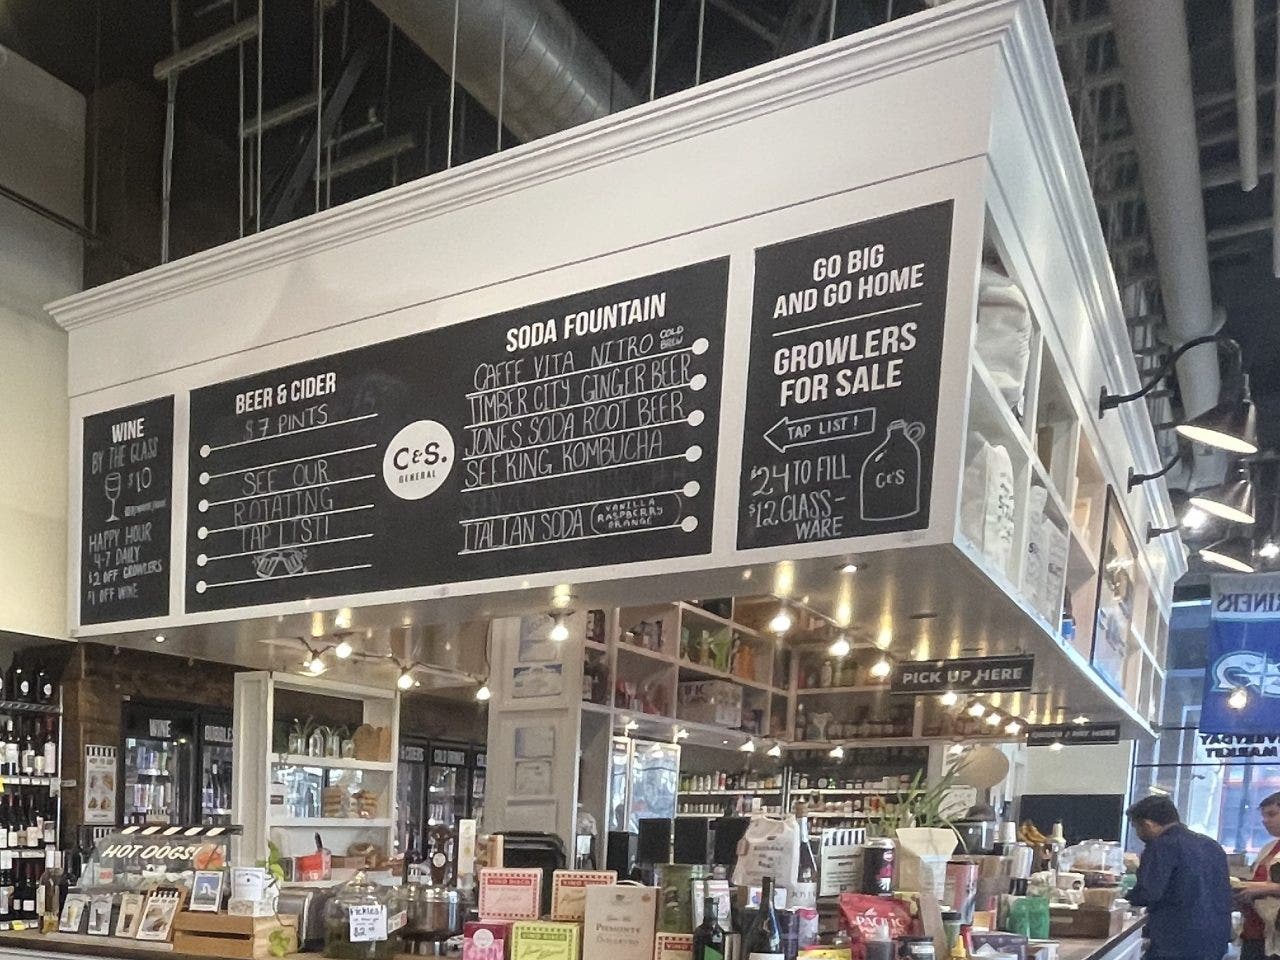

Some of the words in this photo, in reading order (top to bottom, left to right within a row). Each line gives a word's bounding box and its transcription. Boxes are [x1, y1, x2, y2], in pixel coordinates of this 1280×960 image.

[813, 254, 841, 282] GO
[848, 244, 884, 273] BIG
[773, 288, 816, 318] AND
[823, 280, 852, 308] GO
[858, 264, 924, 299] HOME
[506, 318, 557, 352] SODA
[564, 292, 666, 340] FOUNTAIN
[659, 326, 684, 339] COLD
[473, 357, 524, 391] CAFFE
[533, 351, 575, 378] VITA
[590, 333, 654, 368] NITRO
[773, 322, 917, 376] GROWLERS
[236, 388, 272, 415] BEER
[277, 383, 287, 405] &
[291, 372, 337, 402] CIDER
[468, 393, 528, 427] TIMBER
[533, 378, 571, 412] CITY
[581, 364, 646, 403] GINGER
[651, 354, 691, 388] BEER
[780, 373, 828, 407] FOR
[836, 359, 903, 397] SALE
[111, 418, 145, 443] WINE
[278, 404, 328, 435] PINTS
[465, 421, 522, 457] JONES
[528, 413, 575, 444] SODA
[582, 401, 629, 436] ROOT
[637, 391, 687, 427] BEER
[787, 426, 811, 441] TAP
[91, 450, 104, 474] BY
[110, 445, 126, 470] THE
[130, 436, 159, 464] GLASS
[563, 430, 663, 471] KOMBUCHA
[241, 468, 275, 496] SEE
[293, 459, 331, 487] OUR
[398, 469, 437, 484] GENERAL
[750, 464, 789, 497] $24
[793, 460, 811, 484] TO
[816, 454, 851, 482] FILL
[233, 487, 333, 528] ROTATING
[606, 498, 655, 511] VANILLA
[749, 501, 779, 528] $12
[89, 529, 120, 553] HAPPY
[125, 521, 152, 545] HOUR
[240, 523, 270, 552] TAP
[461, 518, 535, 553] ITALIAN
[541, 509, 583, 541] SODA
[795, 516, 843, 540] WARE
[116, 545, 141, 566] DAILY
[902, 670, 941, 685] PICK
[946, 669, 972, 683] UP
[976, 666, 1023, 682] HERE
[102, 845, 141, 858] HOT
